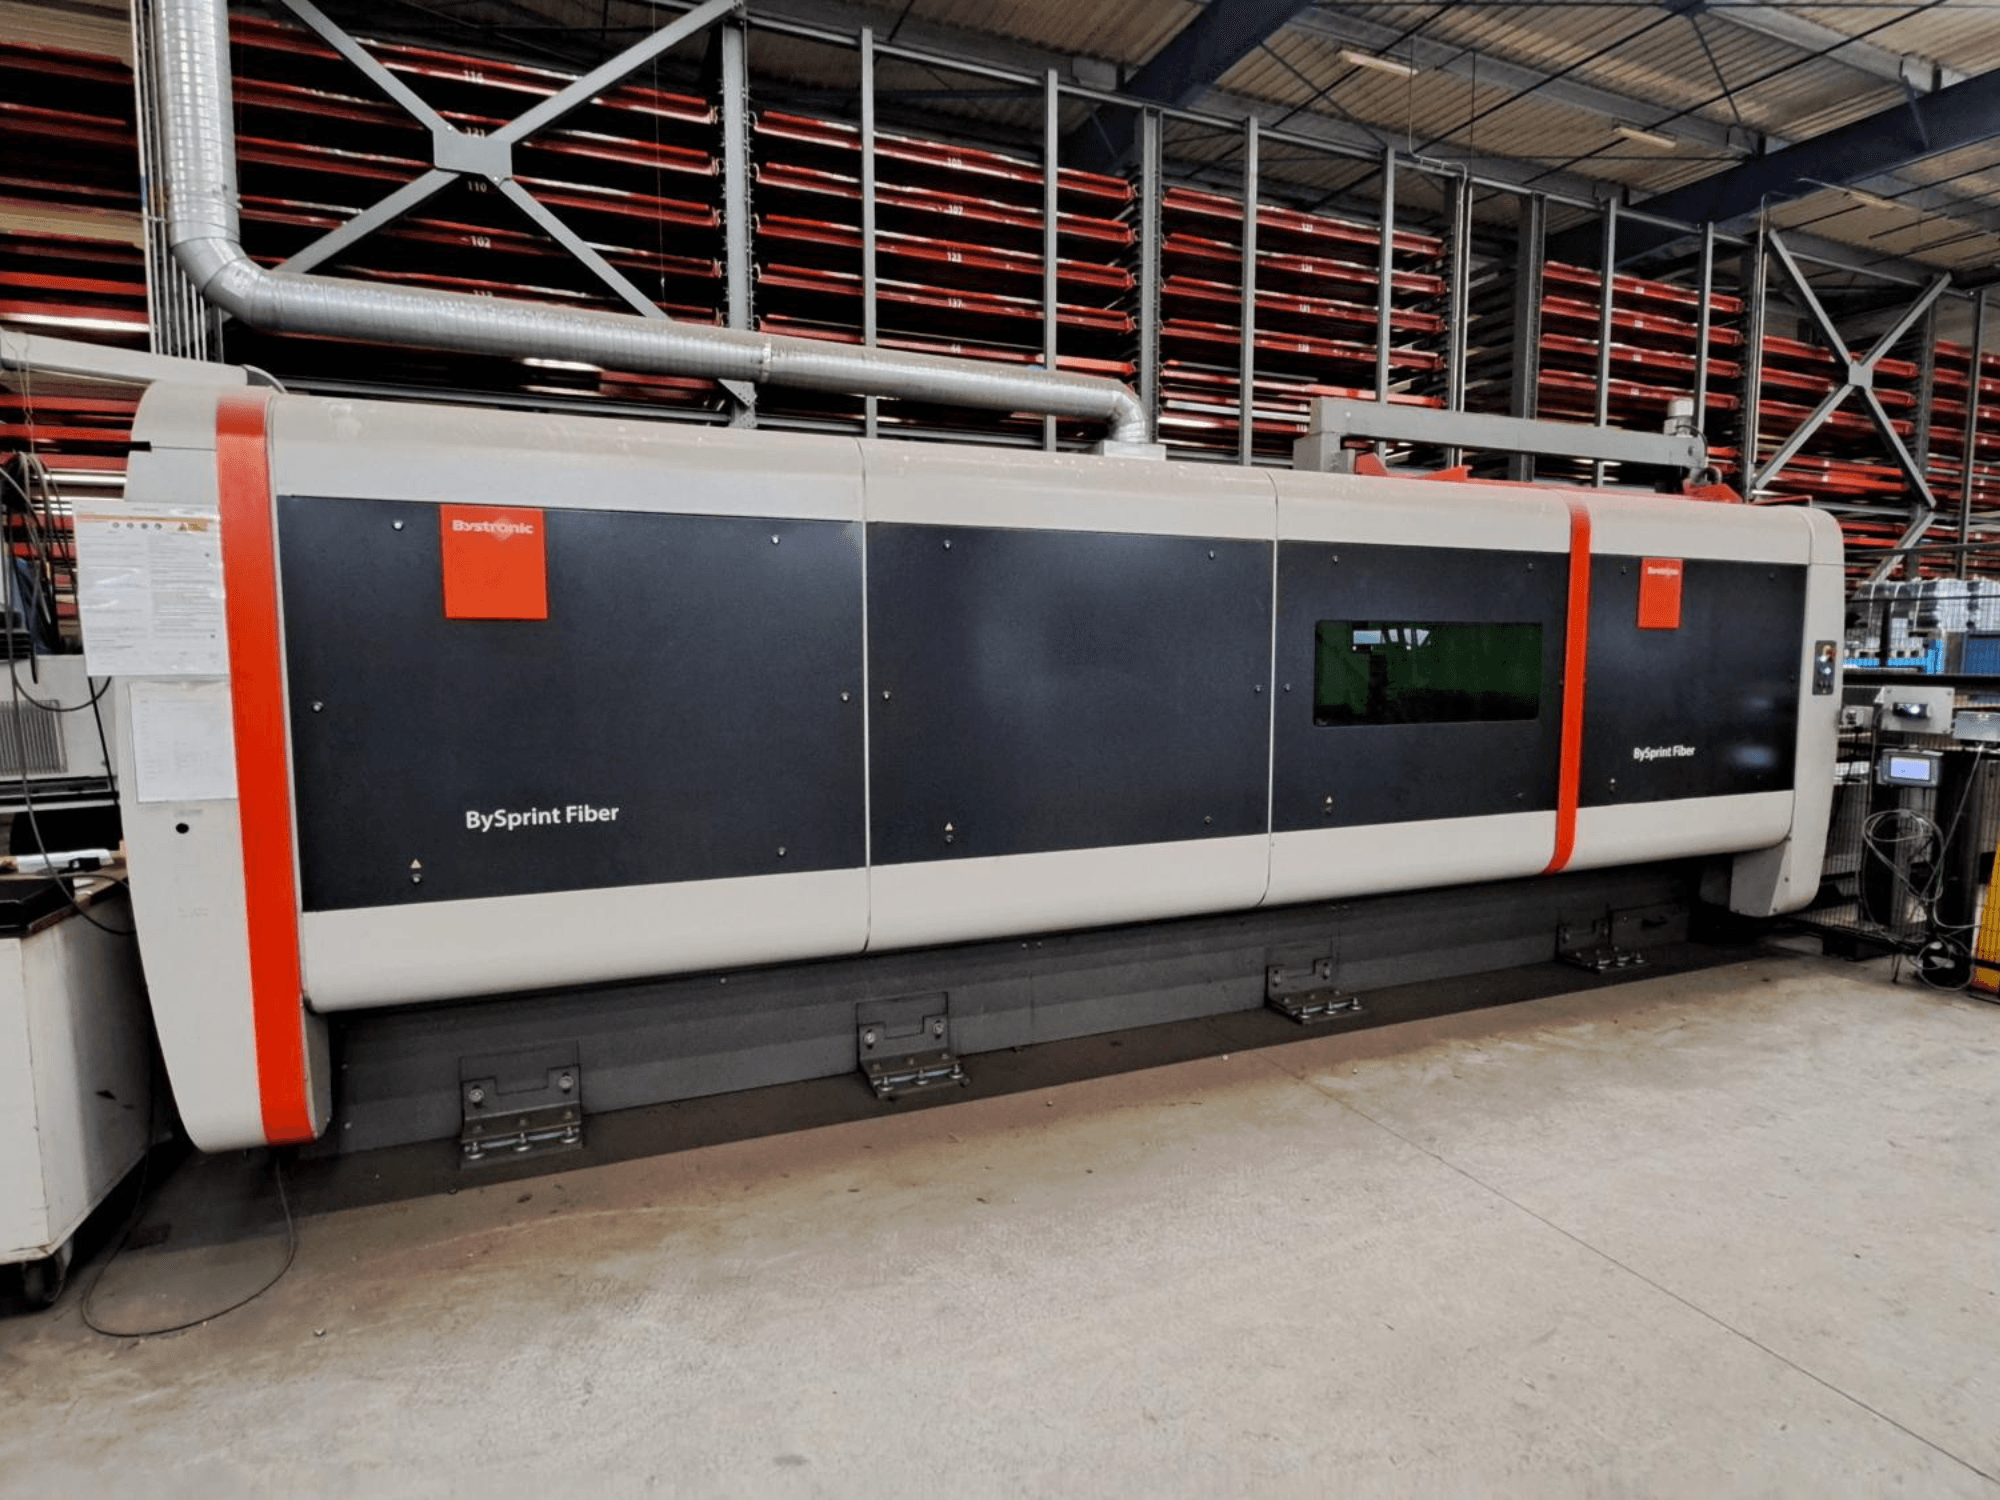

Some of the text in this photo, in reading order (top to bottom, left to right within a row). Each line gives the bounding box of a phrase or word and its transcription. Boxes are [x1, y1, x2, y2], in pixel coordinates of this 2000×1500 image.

[467, 181, 487, 193] 110
[471, 235, 491, 249] 102
[452, 519, 534, 534] Bystronic
[1633, 744, 1696, 762] BySprint Fiber
[465, 804, 620, 832] BySprint Fiber
